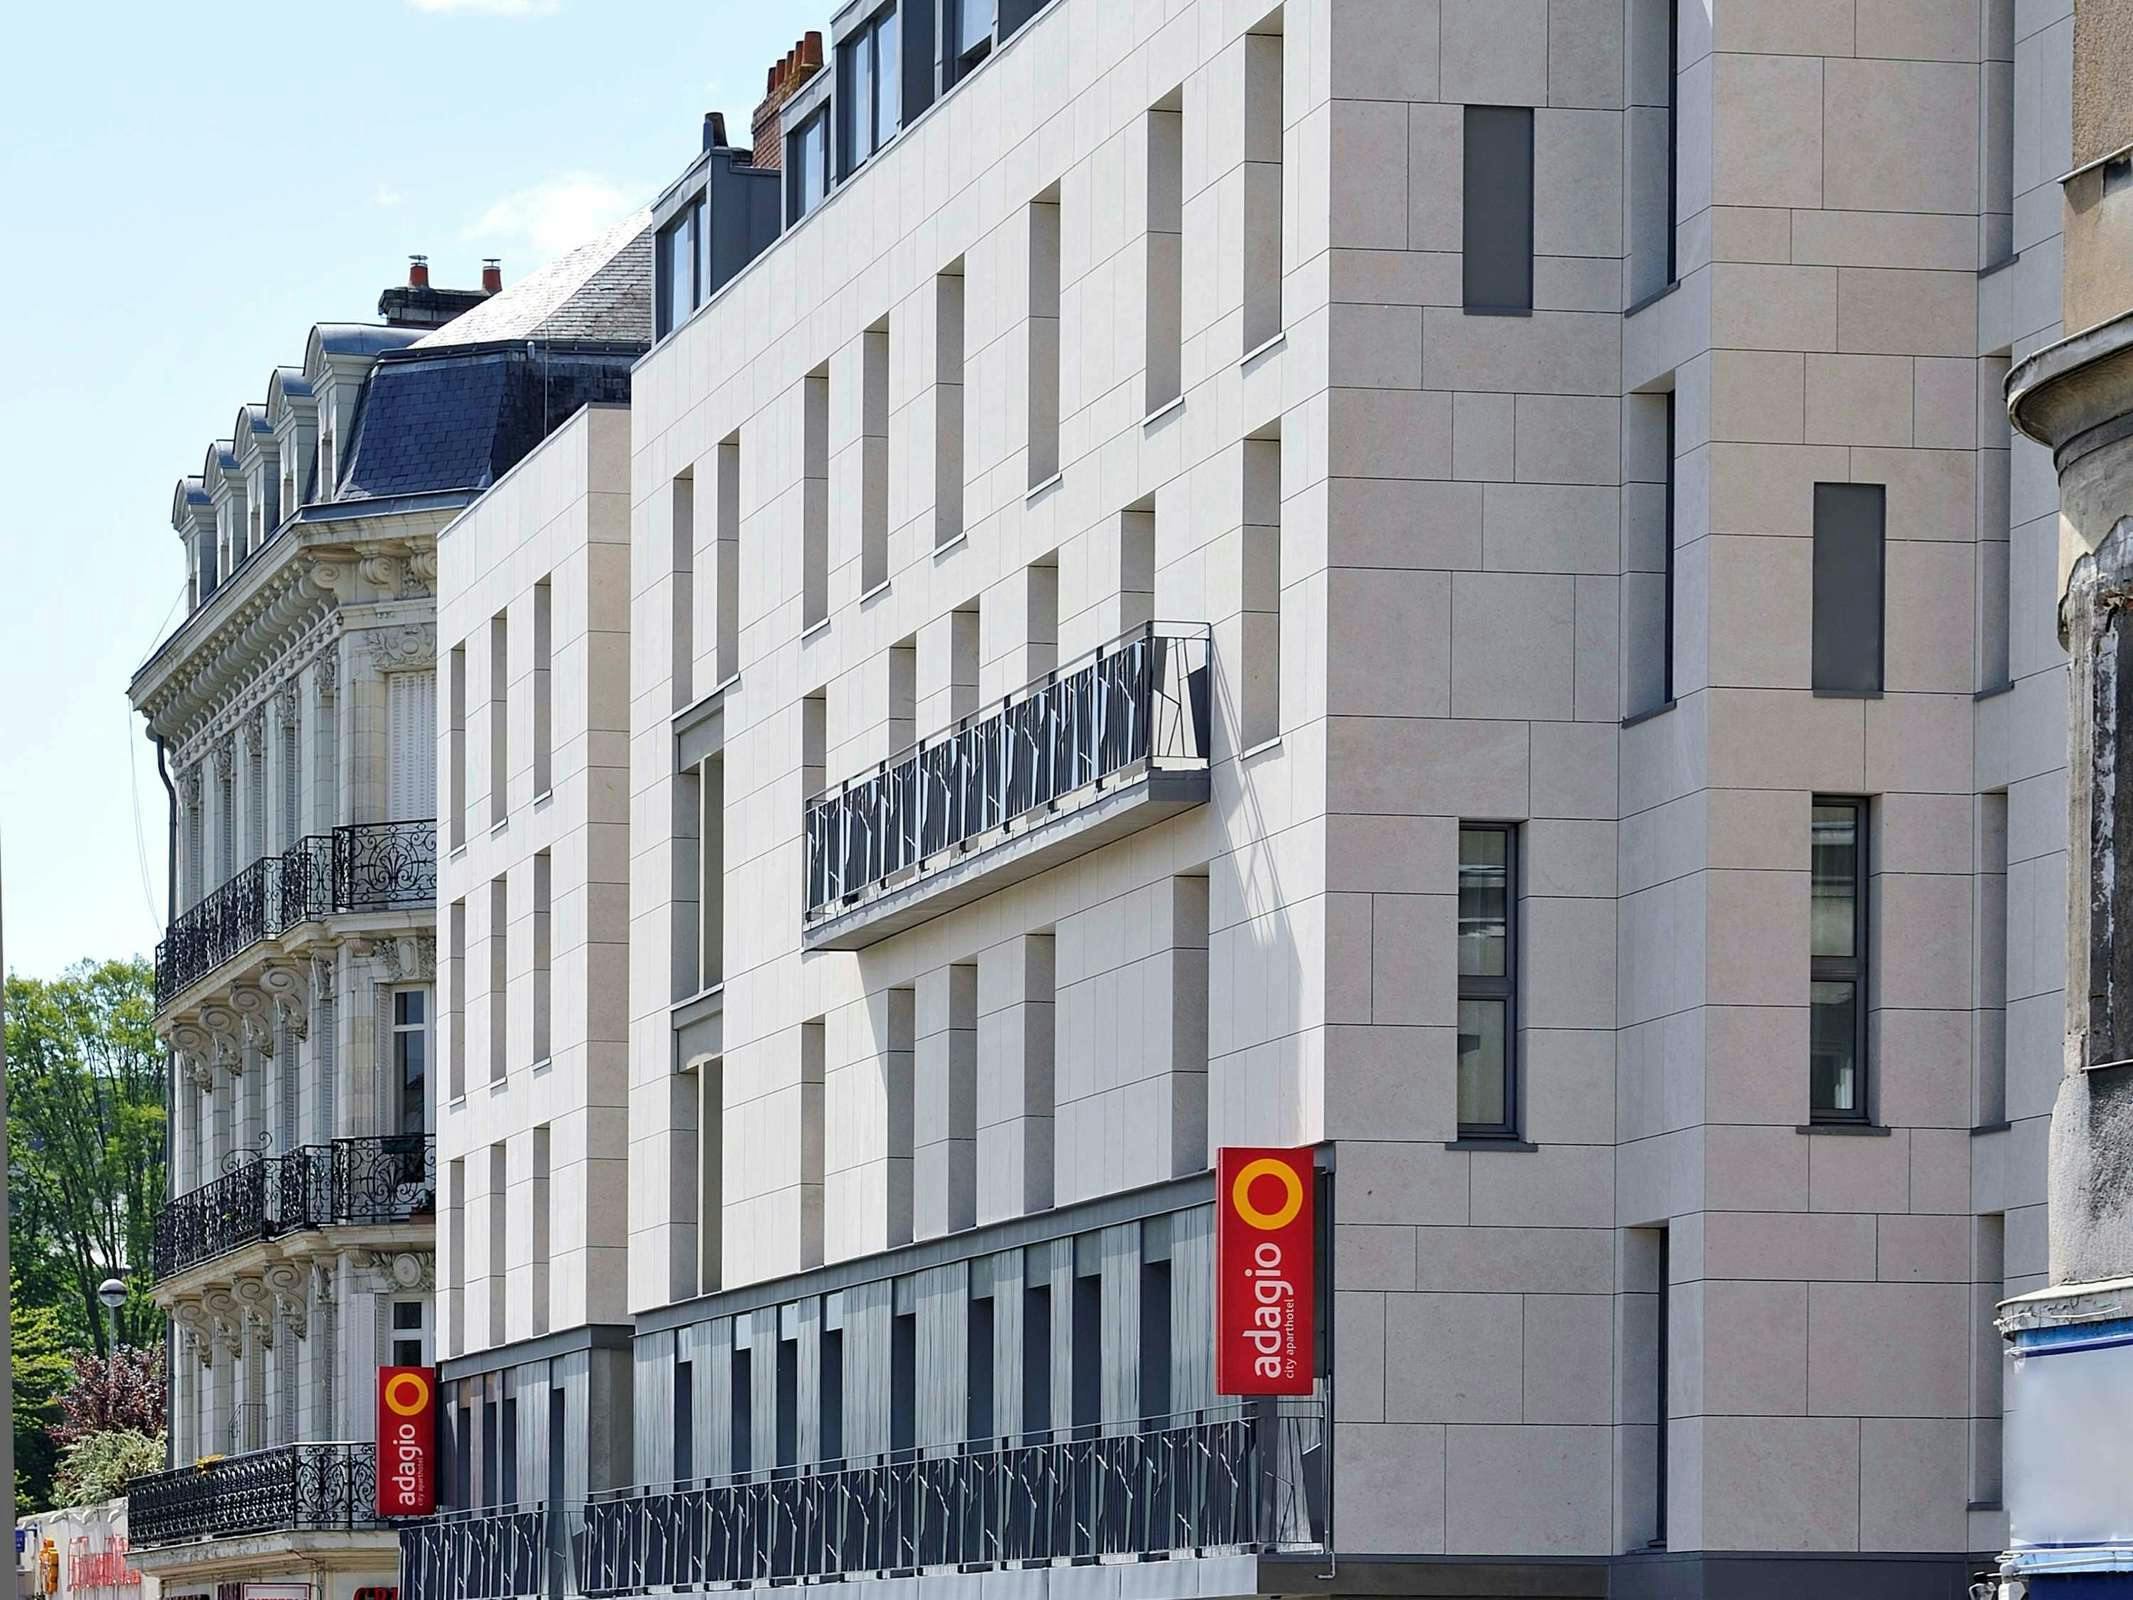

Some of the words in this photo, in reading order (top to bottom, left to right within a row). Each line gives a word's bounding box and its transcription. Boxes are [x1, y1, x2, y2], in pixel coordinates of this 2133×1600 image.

[1242, 1242, 1294, 1379] adagio
[1283, 1299, 1296, 1356] aparthotel
[1283, 1358, 1296, 1379] city
[391, 1423, 423, 1506] adagio
